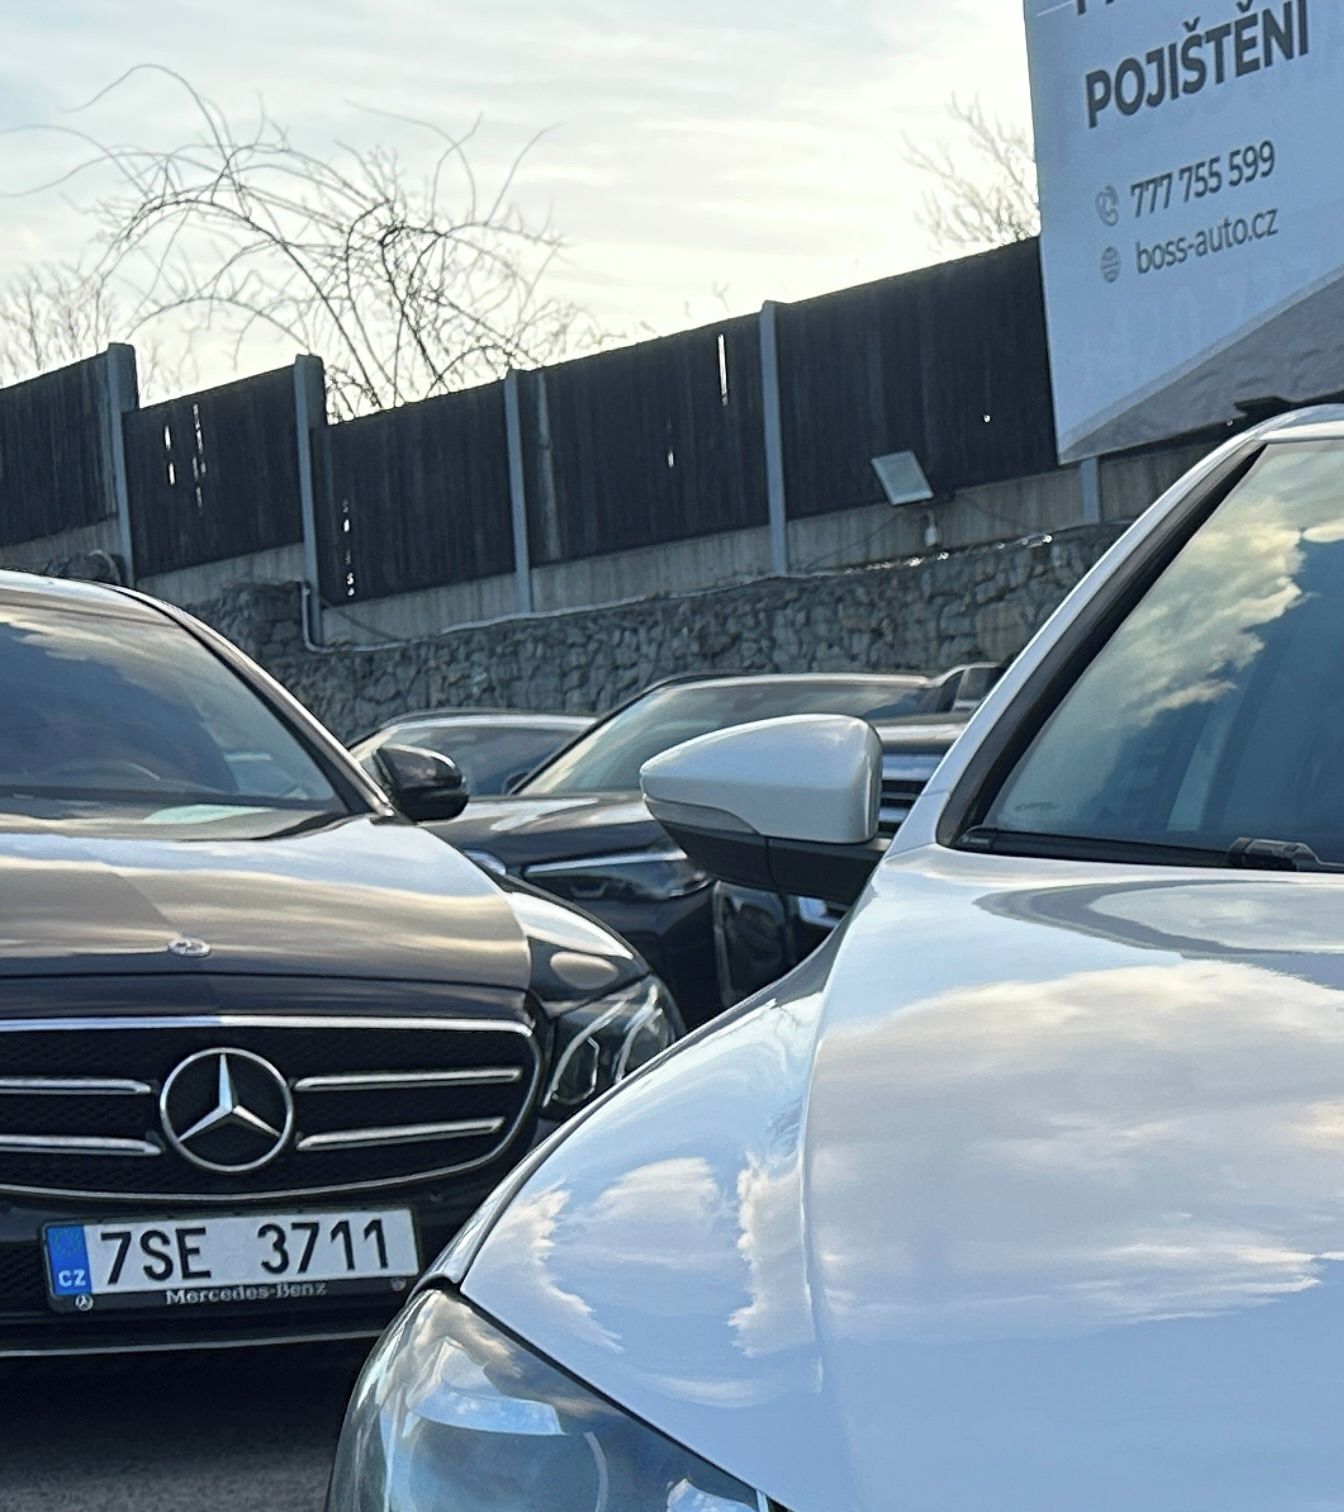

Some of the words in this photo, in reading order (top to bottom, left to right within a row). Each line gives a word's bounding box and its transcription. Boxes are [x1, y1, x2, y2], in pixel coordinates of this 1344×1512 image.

[1130, 172, 1173, 219] 777
[1179, 156, 1222, 203] 755
[1228, 140, 1276, 187] 599
[1135, 208, 1279, 275] boss-auto.cz
[58, 1269, 87, 1288] CZ
[101, 1227, 212, 1285] 7SE
[257, 1219, 389, 1275] 3711
